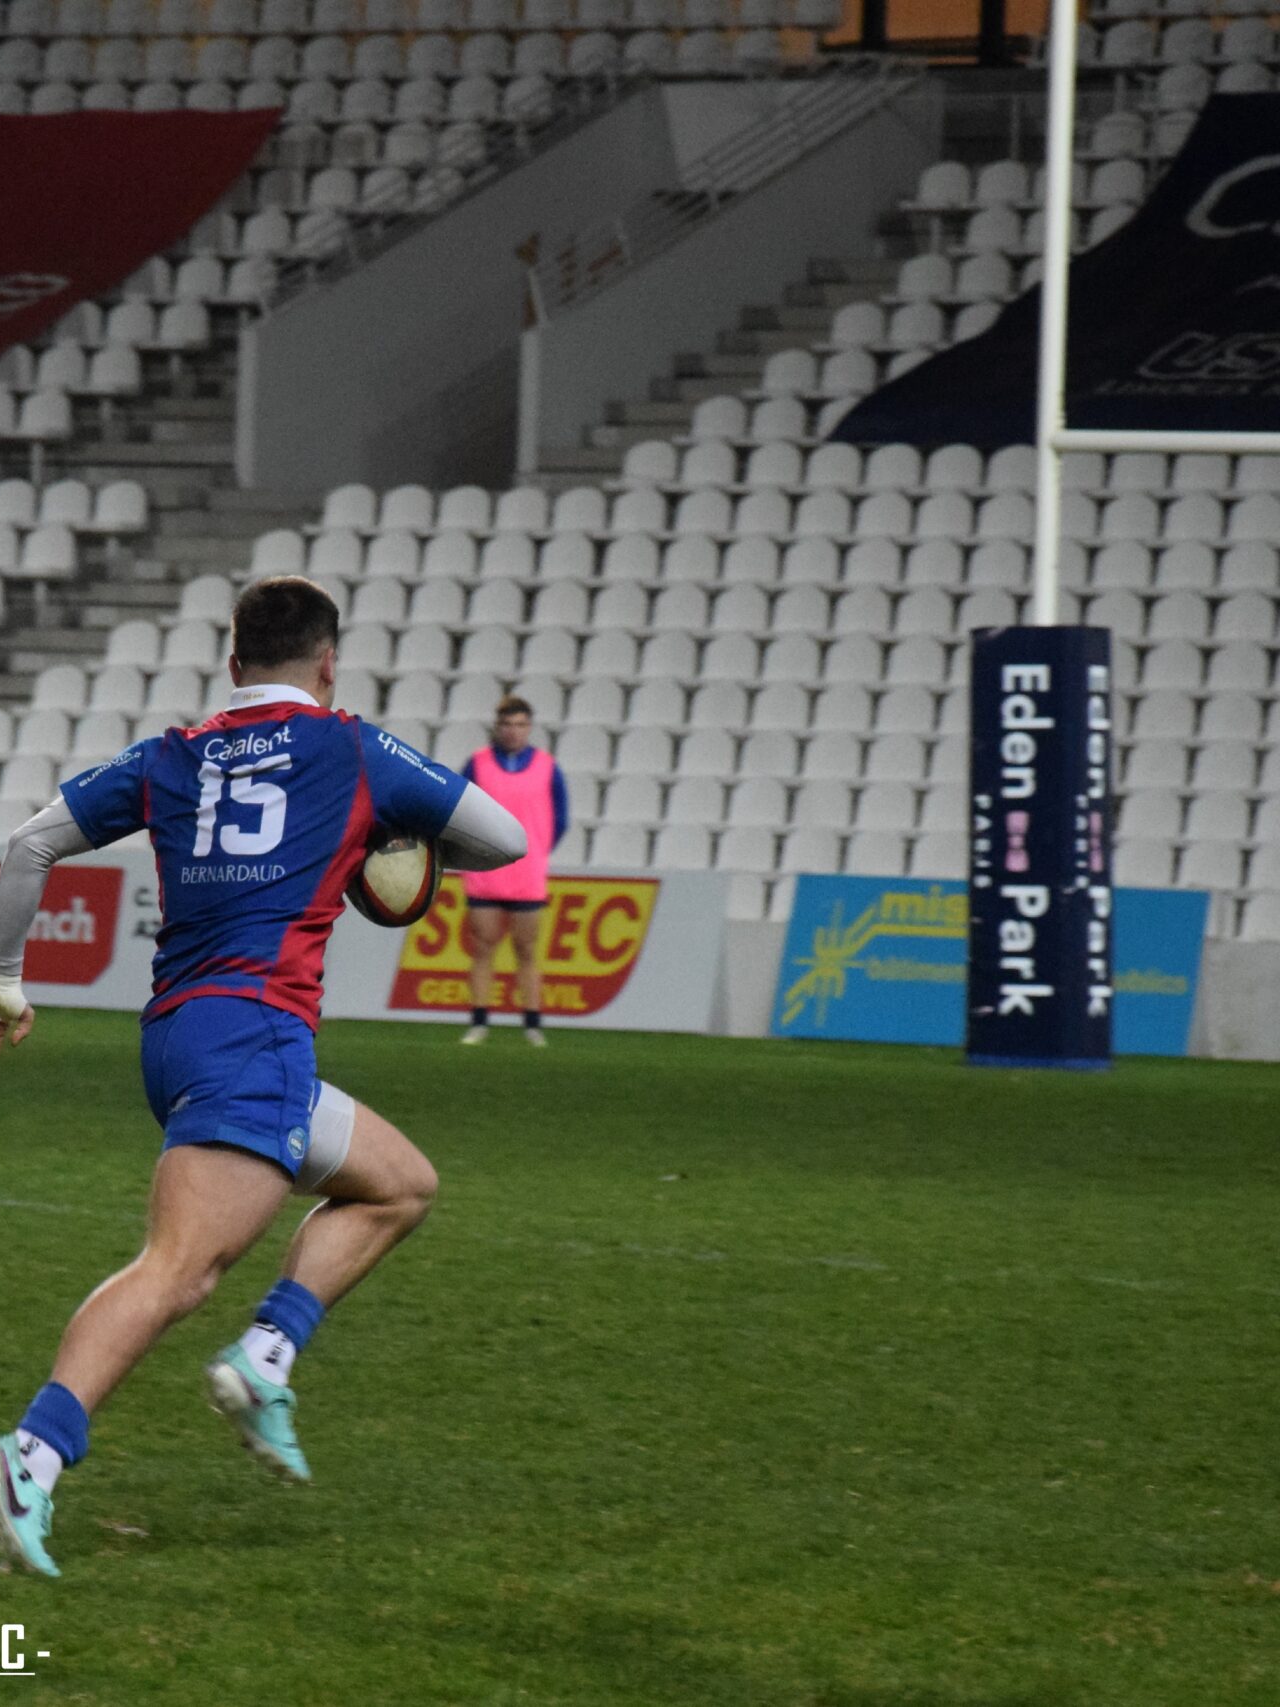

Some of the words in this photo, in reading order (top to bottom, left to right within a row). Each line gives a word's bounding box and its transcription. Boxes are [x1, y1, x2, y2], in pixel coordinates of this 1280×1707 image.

[1000, 663, 1055, 800] Eden
[193, 753, 293, 857] 15
[181, 864, 286, 884] BERNARDAUD
[999, 885, 1055, 1017] Park
